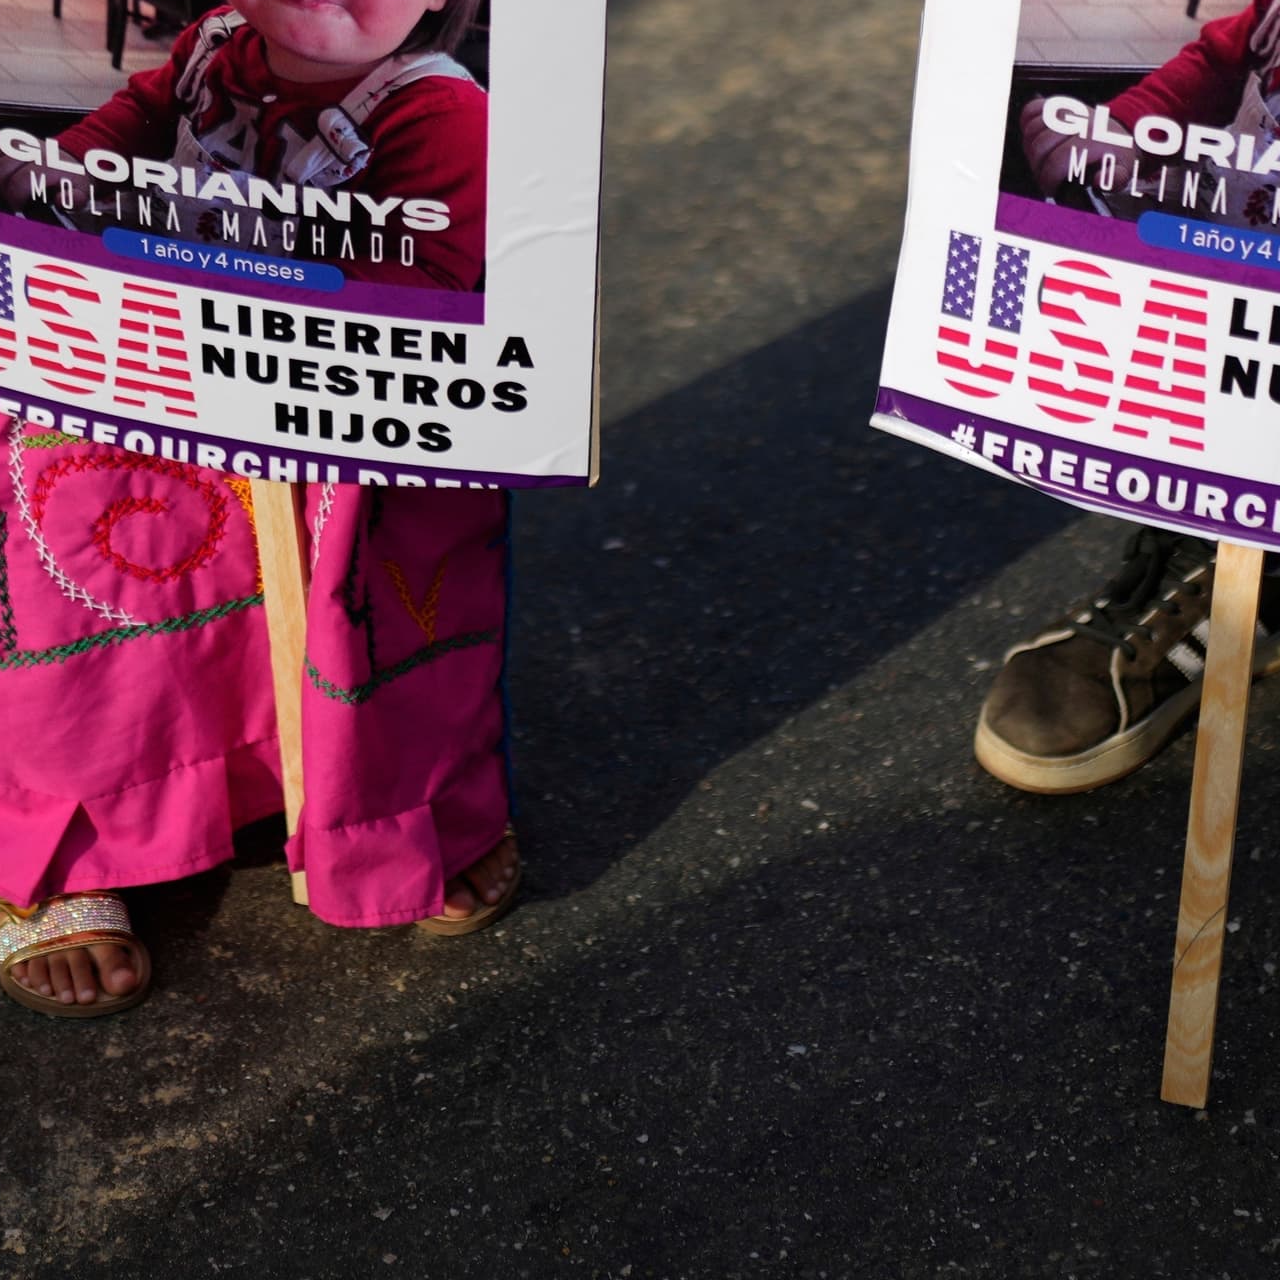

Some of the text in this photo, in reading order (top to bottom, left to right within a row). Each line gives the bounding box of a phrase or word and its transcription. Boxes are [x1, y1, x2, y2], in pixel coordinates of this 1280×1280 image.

[1068, 146, 1228, 215] MOLINA
[30, 170, 414, 267] MOLINA MACHADO
[1179, 224, 1187, 243] 1
[1193, 227, 1235, 254] año
[1240, 239, 1255, 261] y
[1256, 239, 1272, 259] 4
[141, 238, 305, 281] 1 año y 4 meses
[201, 298, 534, 368] LIBEREN A
[936, 230, 1208, 451] USA
[202, 343, 528, 412] NUESTROS
[275, 402, 453, 453] HIJOS
